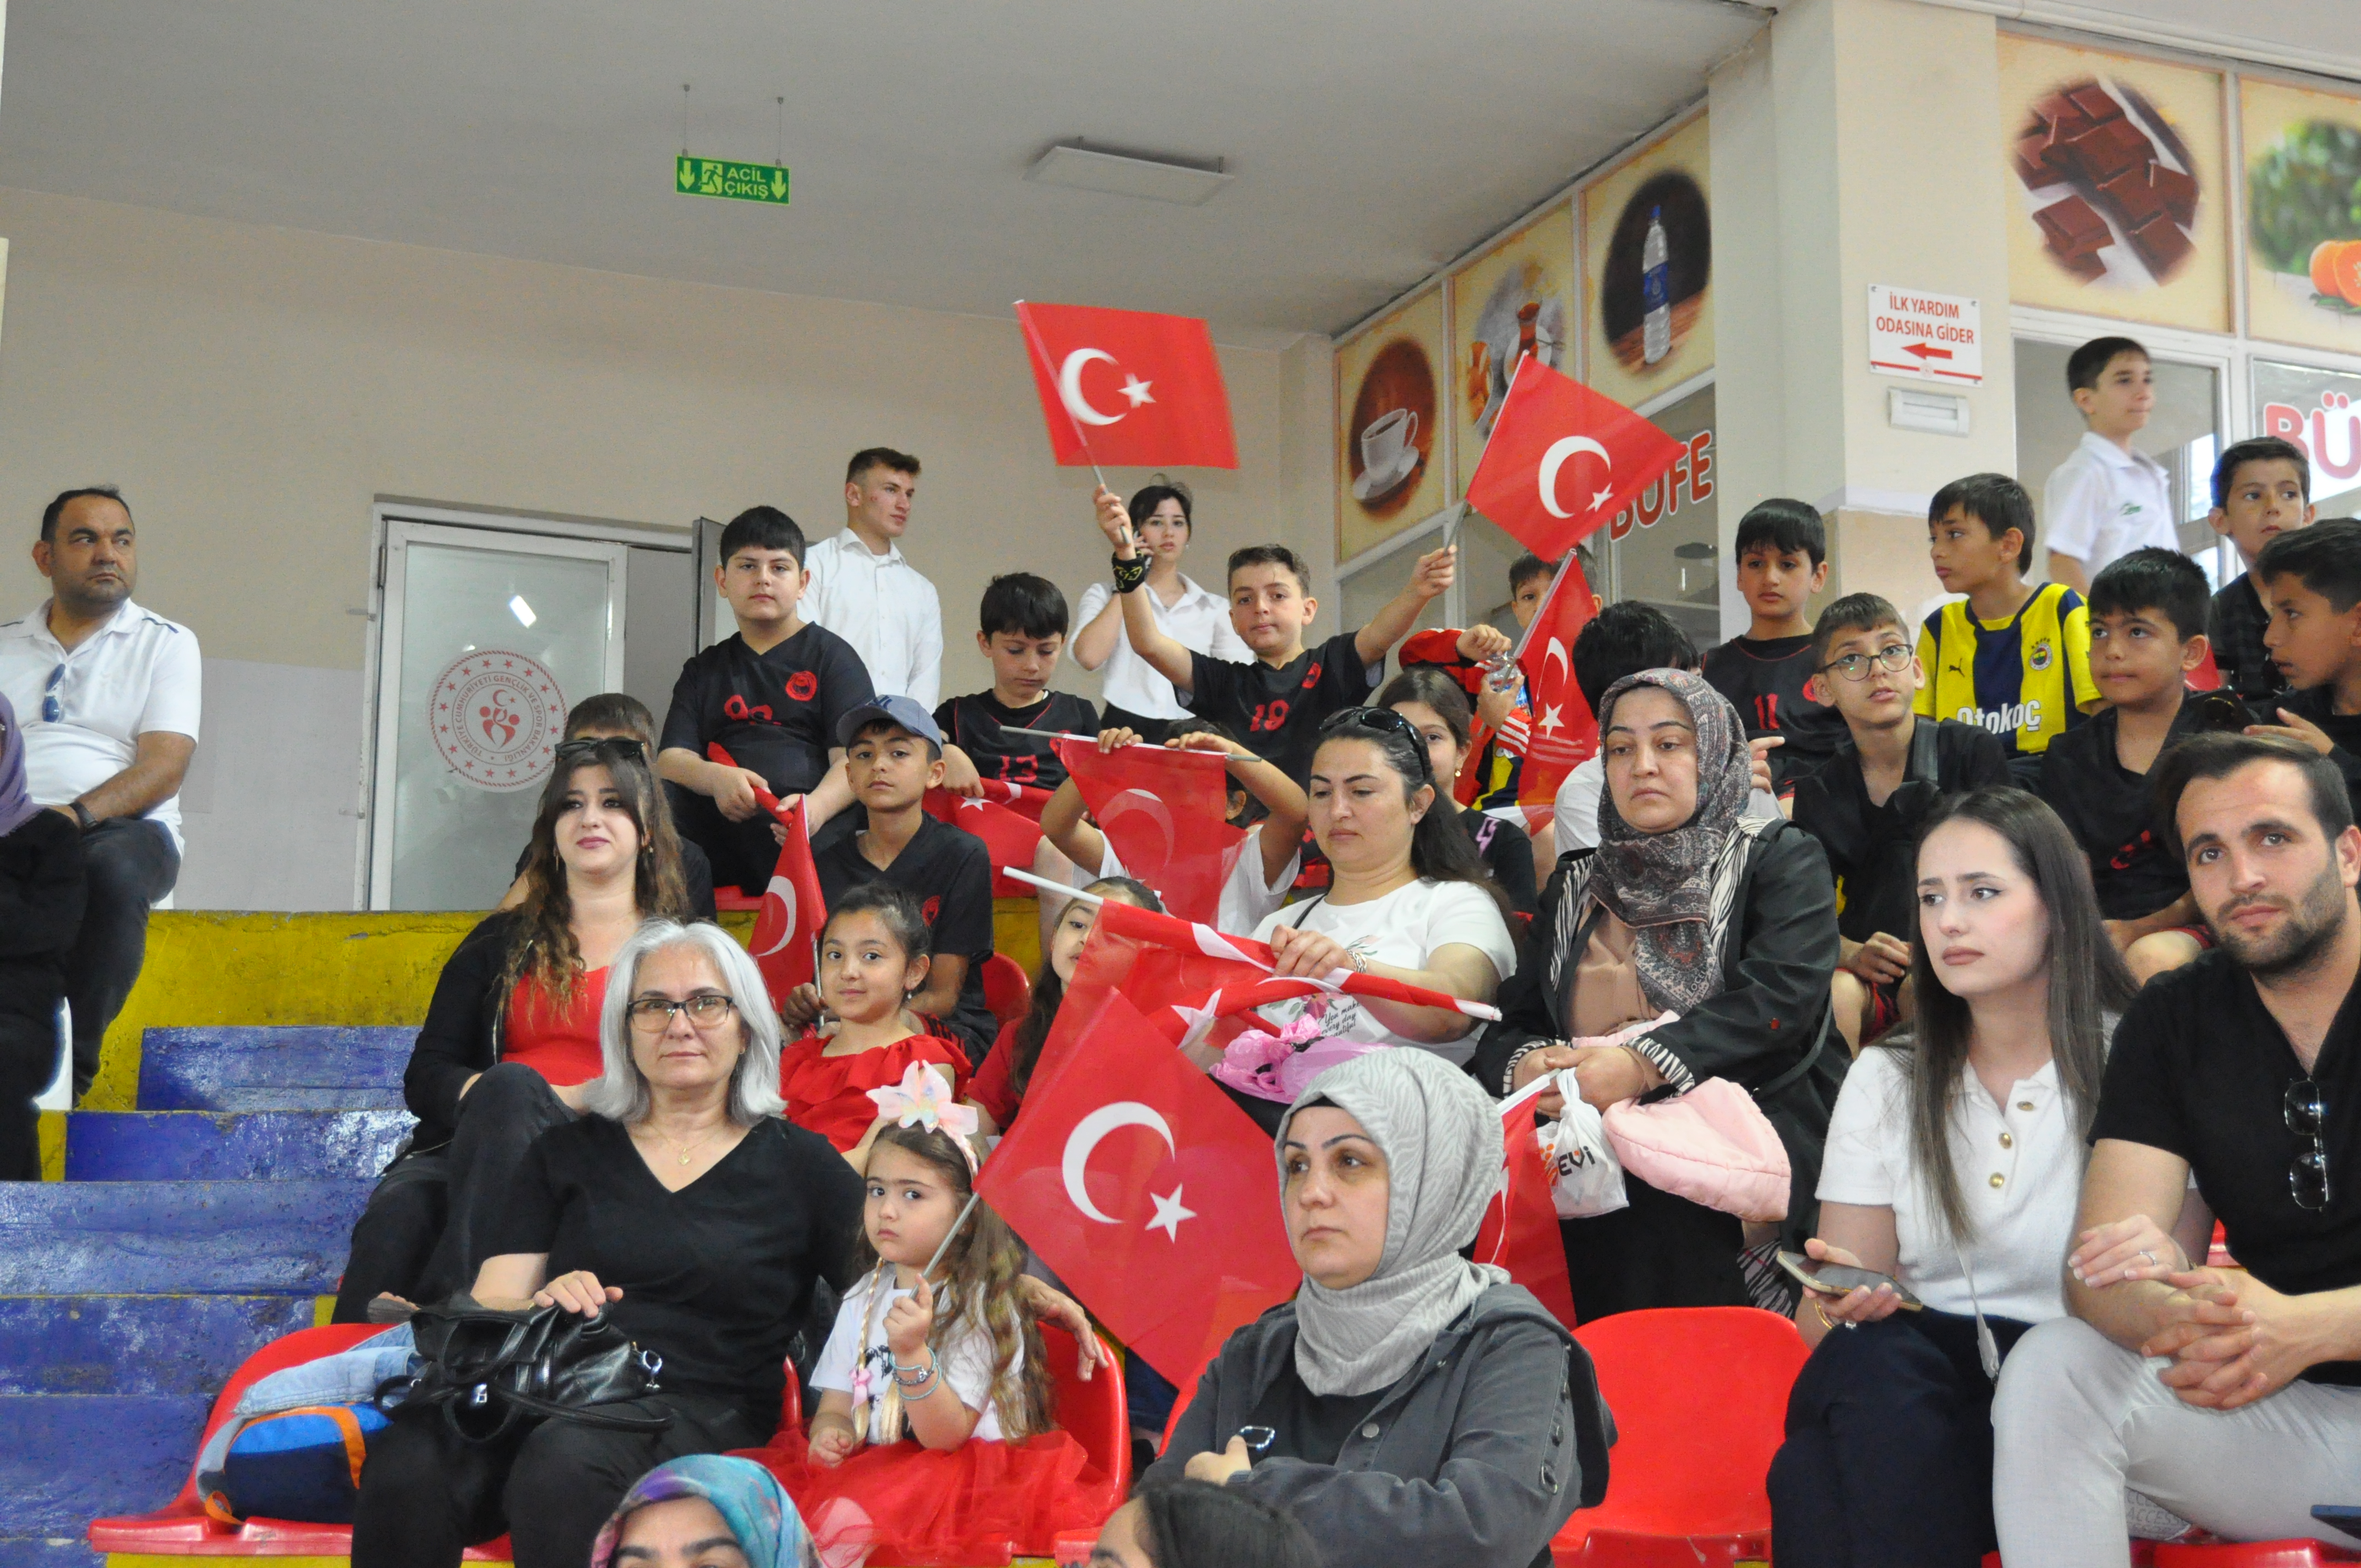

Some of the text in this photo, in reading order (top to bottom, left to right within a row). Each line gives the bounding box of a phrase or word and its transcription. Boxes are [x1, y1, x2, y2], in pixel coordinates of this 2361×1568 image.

[727, 166, 766, 183] ACİL
[725, 181, 769, 199] ÇIKIŞ
[1890, 291, 1960, 319] İLK YARDIM
[1876, 316, 1974, 344] ODASINA GİDER
[455, 675, 542, 762] TÜRKİYE CUMHURİYETİ GENÇLİK VE SPOR BAKANLIĞI
[1250, 699, 1290, 732] 19
[1754, 693, 1780, 731] 11
[999, 754, 1038, 783] 13
[1318, 1012, 1339, 1027] You
[1321, 1013, 1356, 1035] every day
[1325, 1019, 1356, 1037] autiful
